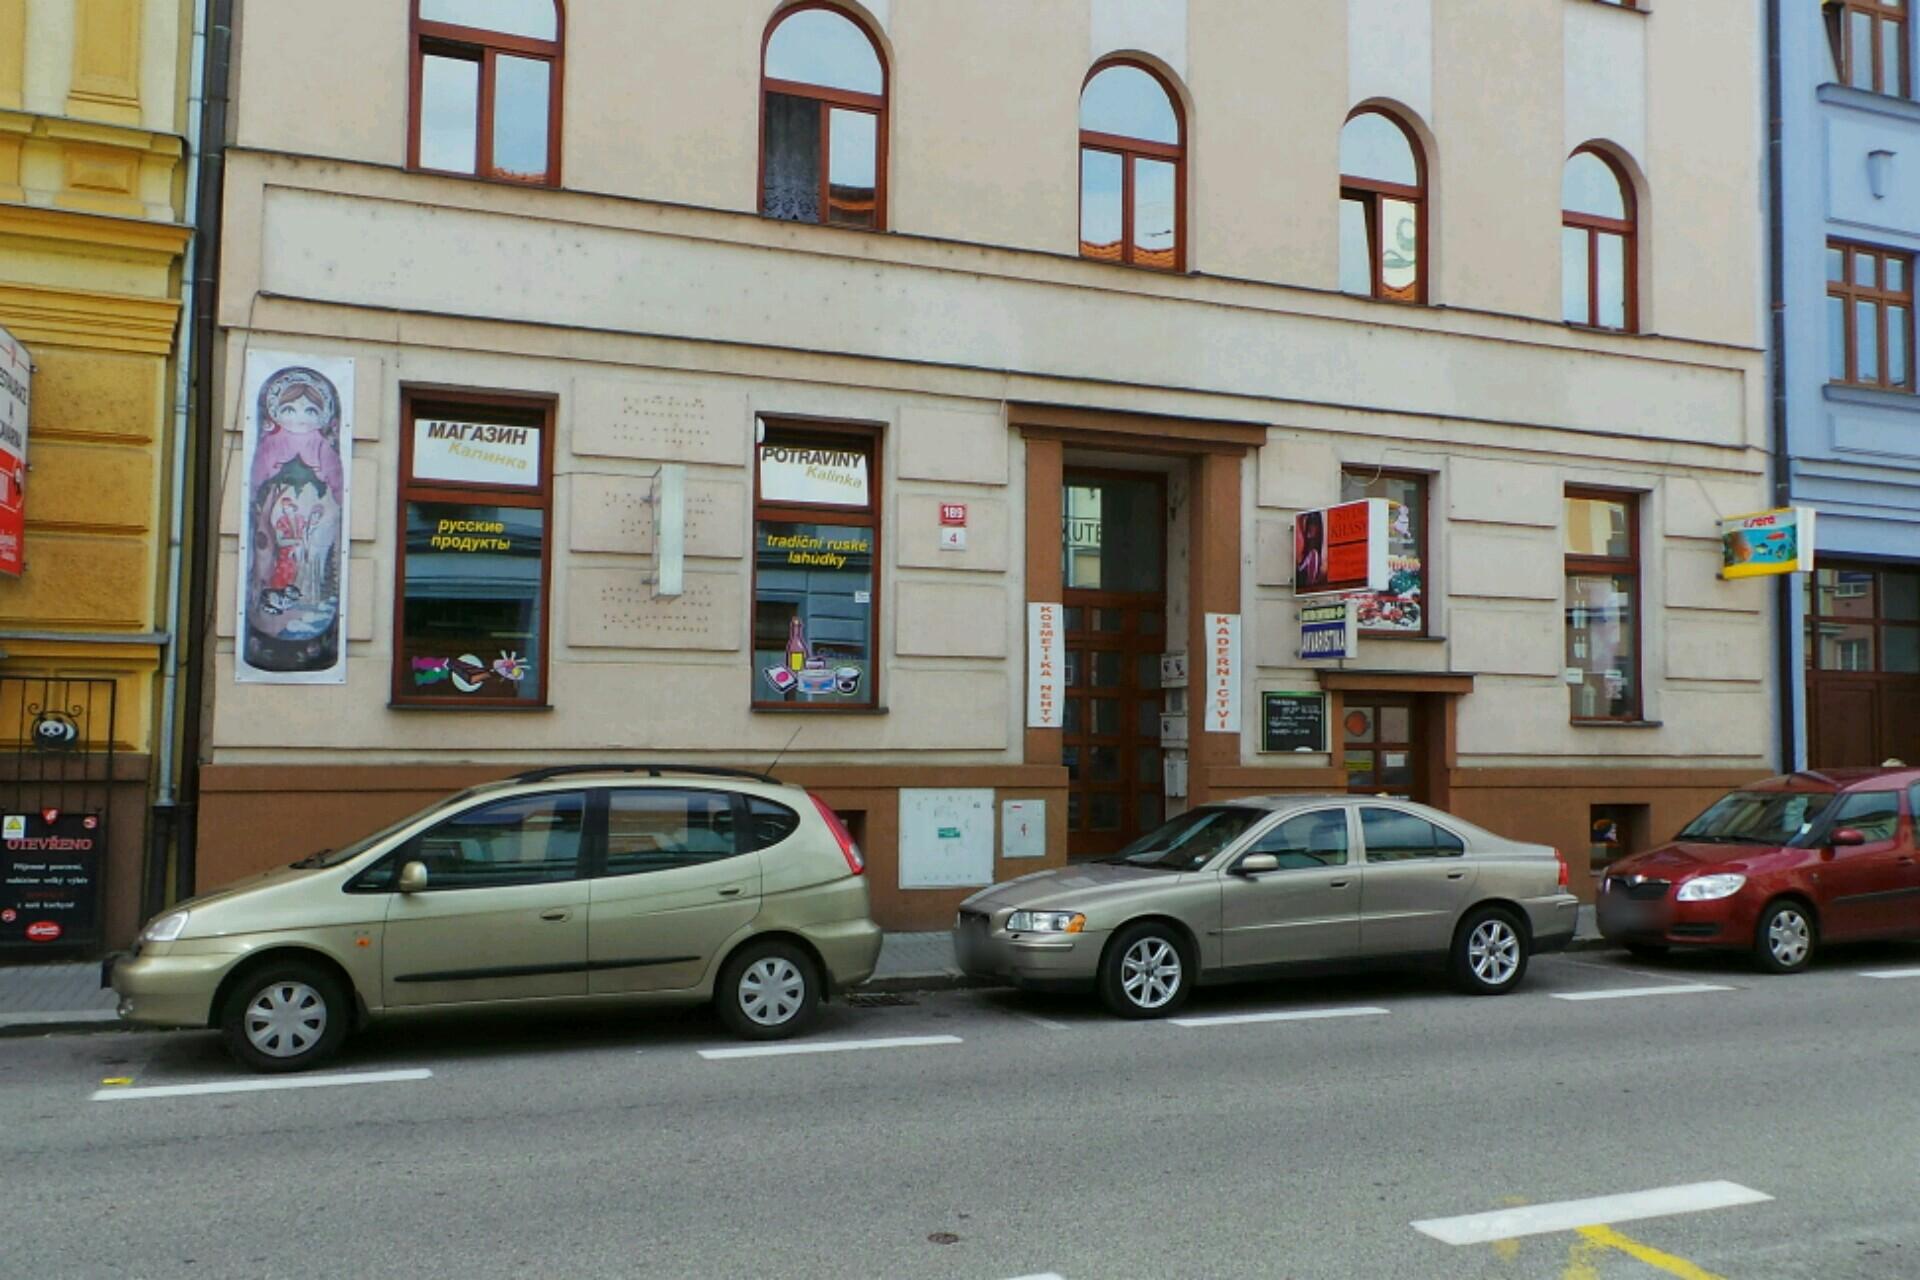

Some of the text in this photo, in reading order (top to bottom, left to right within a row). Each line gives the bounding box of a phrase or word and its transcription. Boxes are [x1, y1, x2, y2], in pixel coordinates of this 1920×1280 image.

[428, 422, 528, 445] МАГАЗИН
[448, 442, 528, 470] Калинка
[762, 448, 862, 468] POTRAVINY
[805, 465, 862, 488] Kalinka
[438, 519, 504, 534] русские
[431, 536, 511, 552] продукты
[767, 534, 868, 552] tradiční ruské
[950, 533, 957, 544] 4
[1040, 606, 1053, 723] KOSMETIKA NEHTY
[6, 836, 93, 850] OTEVŘENO
